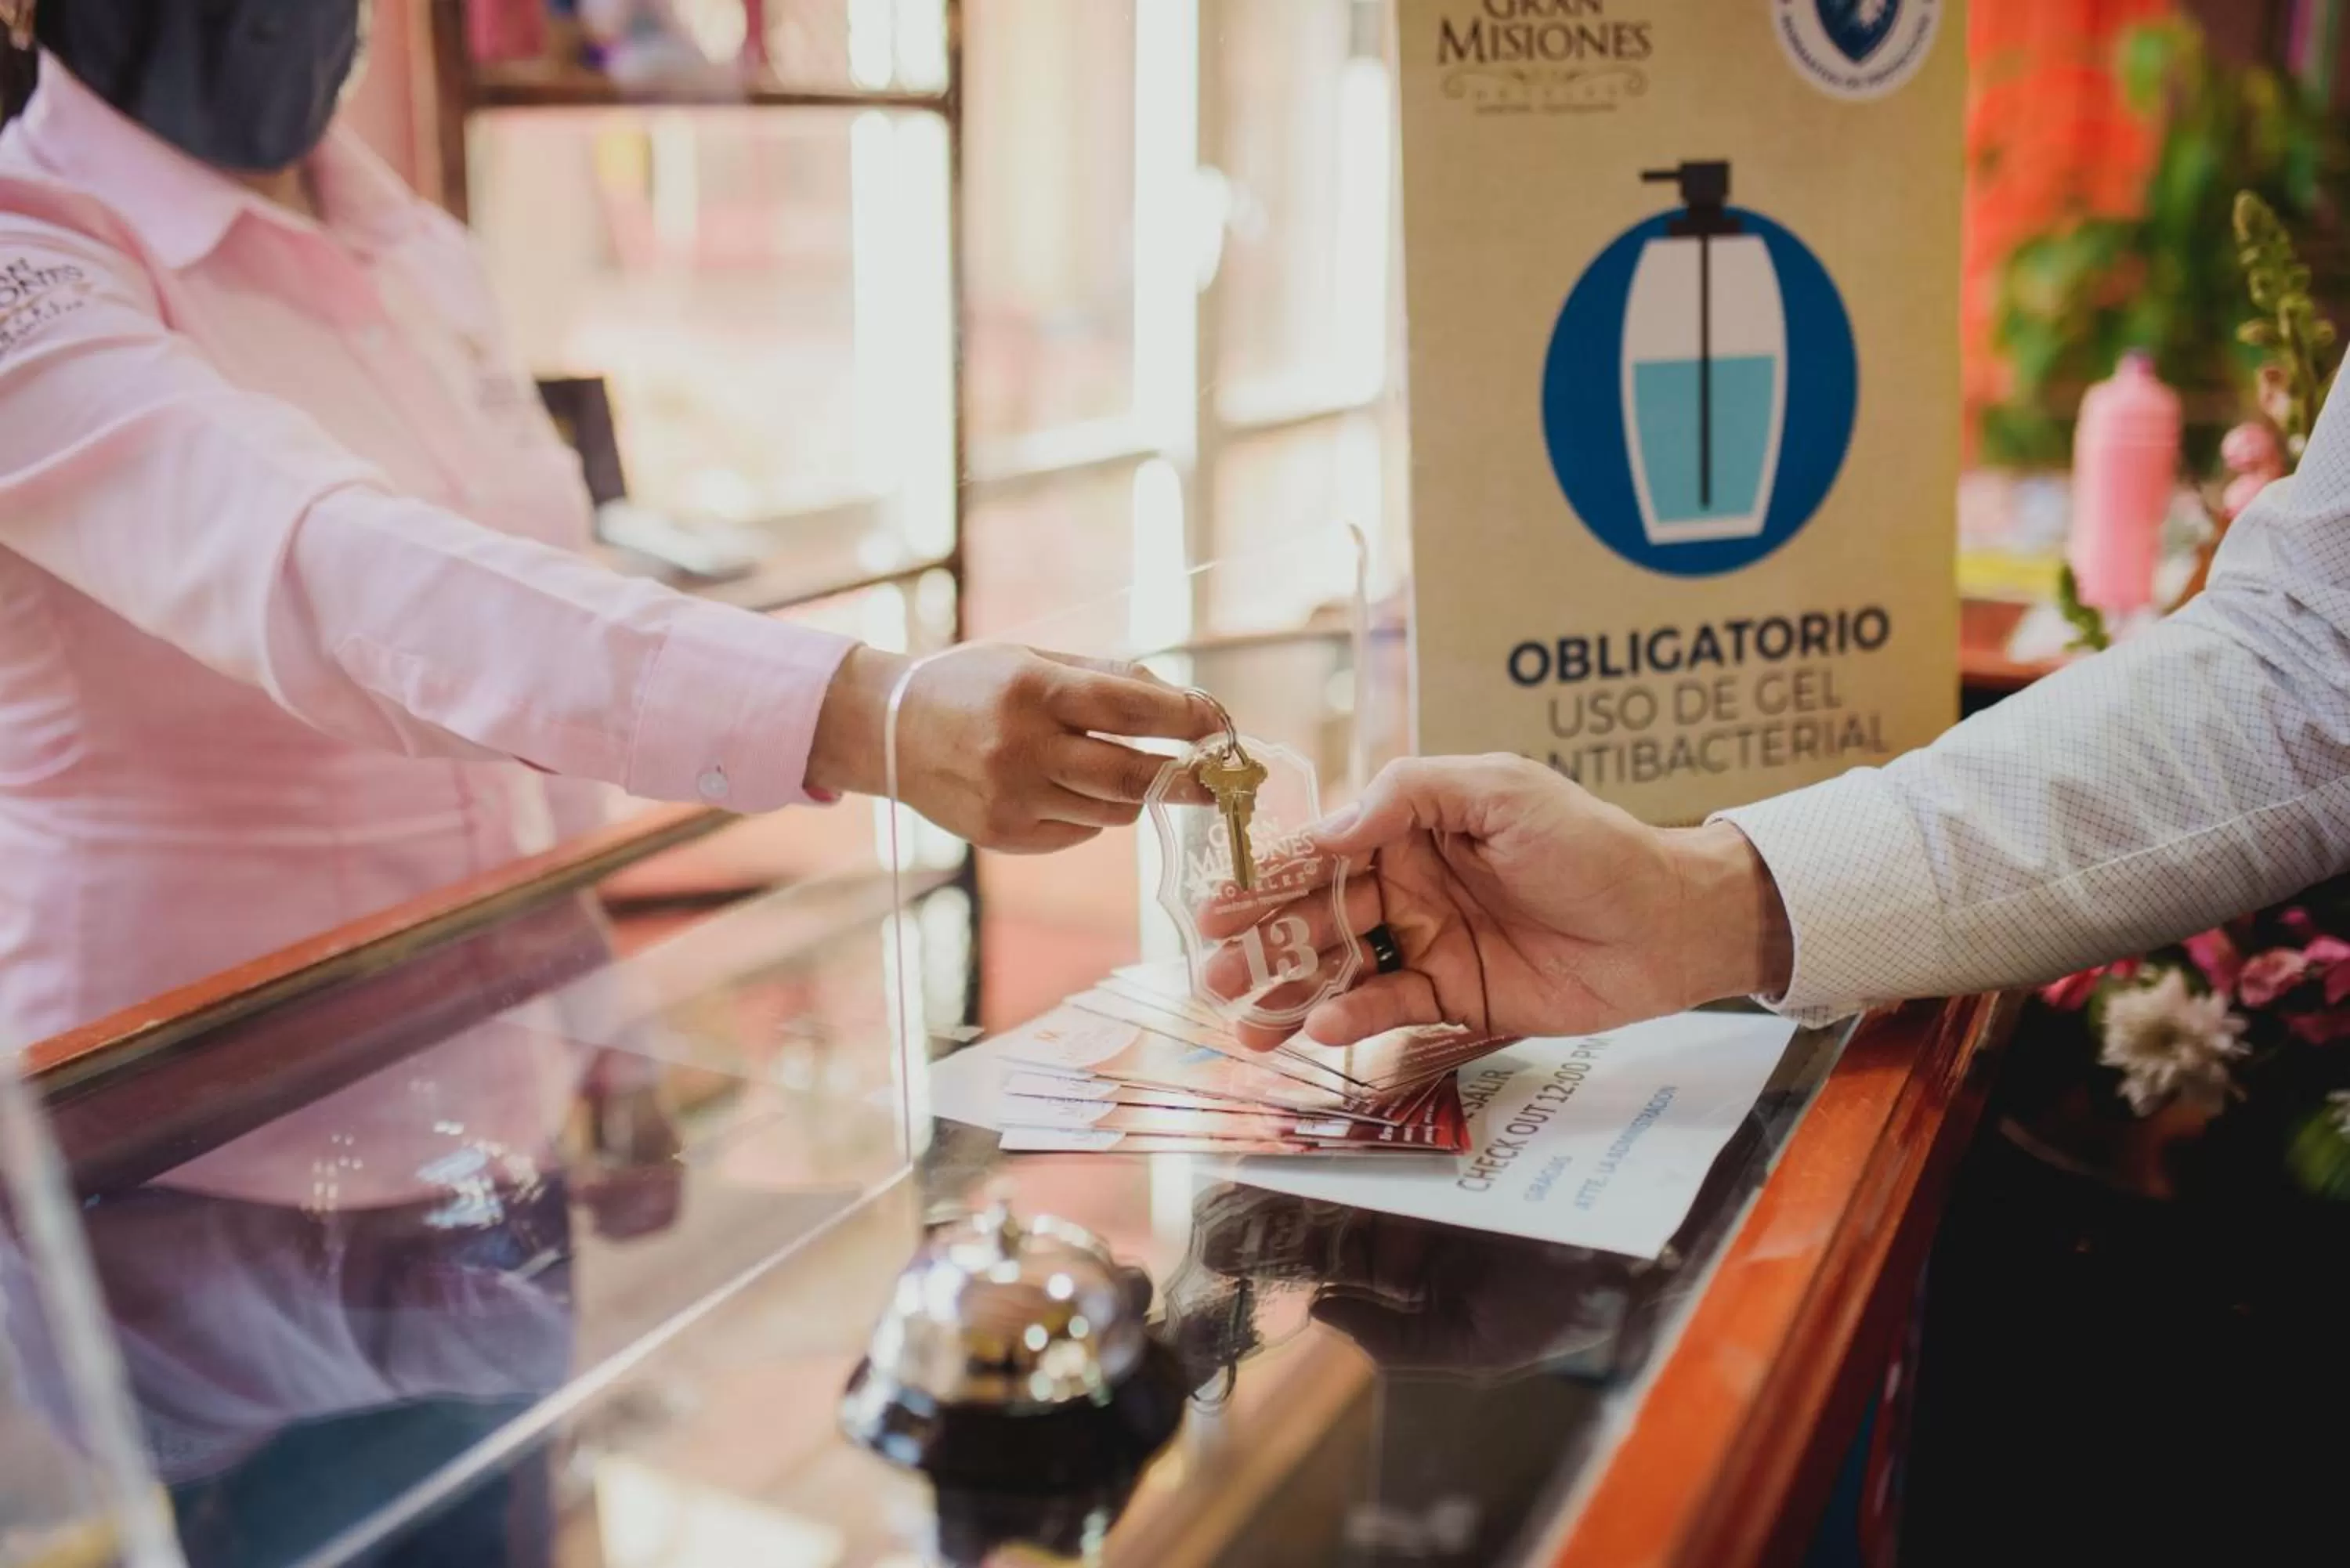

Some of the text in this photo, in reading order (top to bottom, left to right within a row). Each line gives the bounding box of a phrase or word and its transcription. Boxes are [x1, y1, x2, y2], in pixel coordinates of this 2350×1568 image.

[1436, 16, 1654, 66] MISIONES
[1507, 606, 1891, 687] OBLIGATORIO
[1547, 668, 1842, 740] USO DE GEL
[1521, 713, 1890, 786] NTIBACTERIAL
[1236, 916, 1319, 987] 13
[1456, 1037, 1614, 1192] CHECK OUT 12:00 PM
